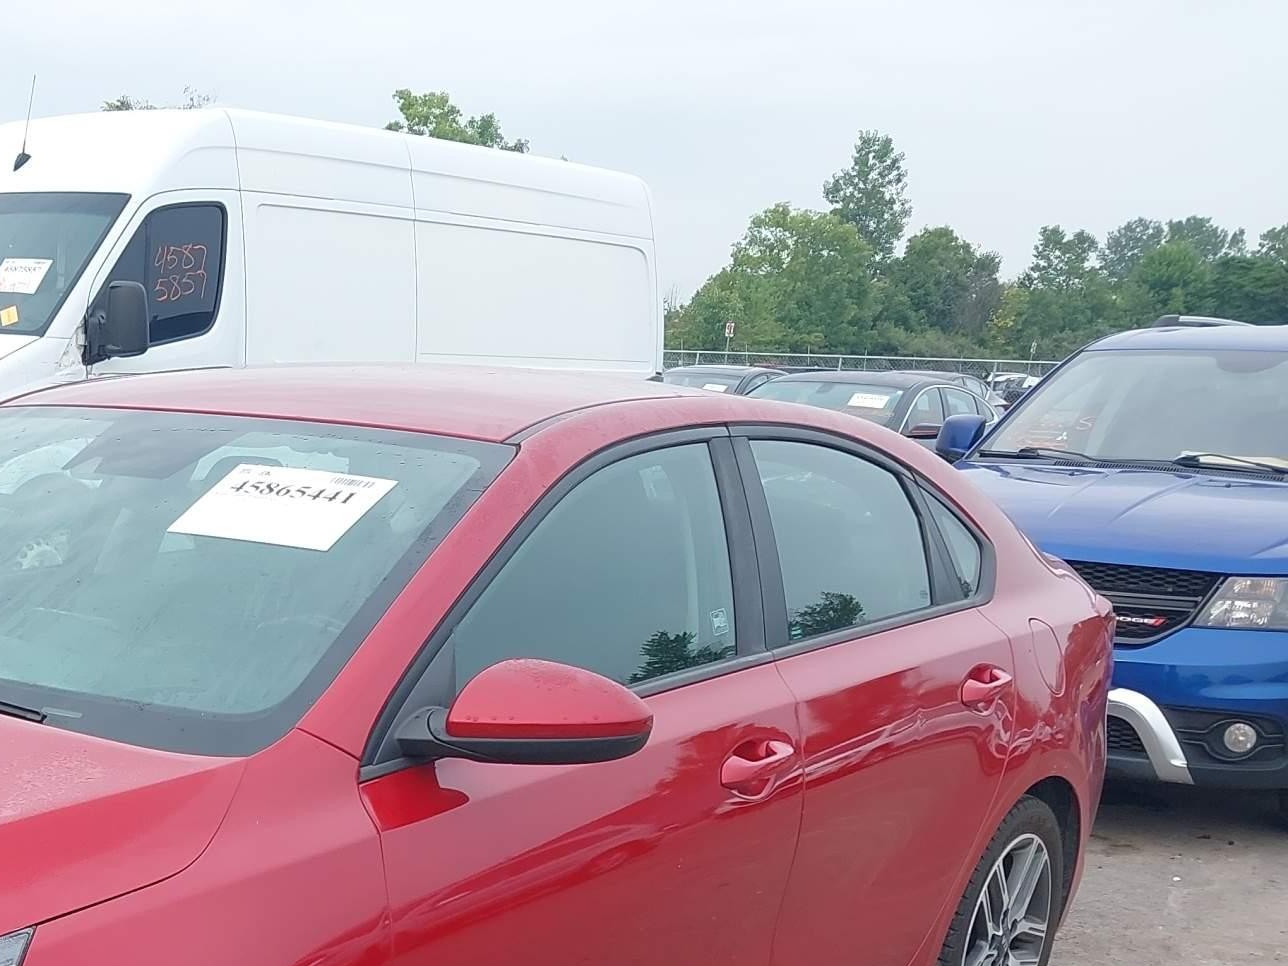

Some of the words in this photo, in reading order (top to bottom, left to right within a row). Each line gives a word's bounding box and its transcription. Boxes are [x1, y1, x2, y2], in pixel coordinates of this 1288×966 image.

[154, 243, 207, 274] 4587
[154, 270, 207, 300] 5857
[230, 480, 357, 504] 45865441
